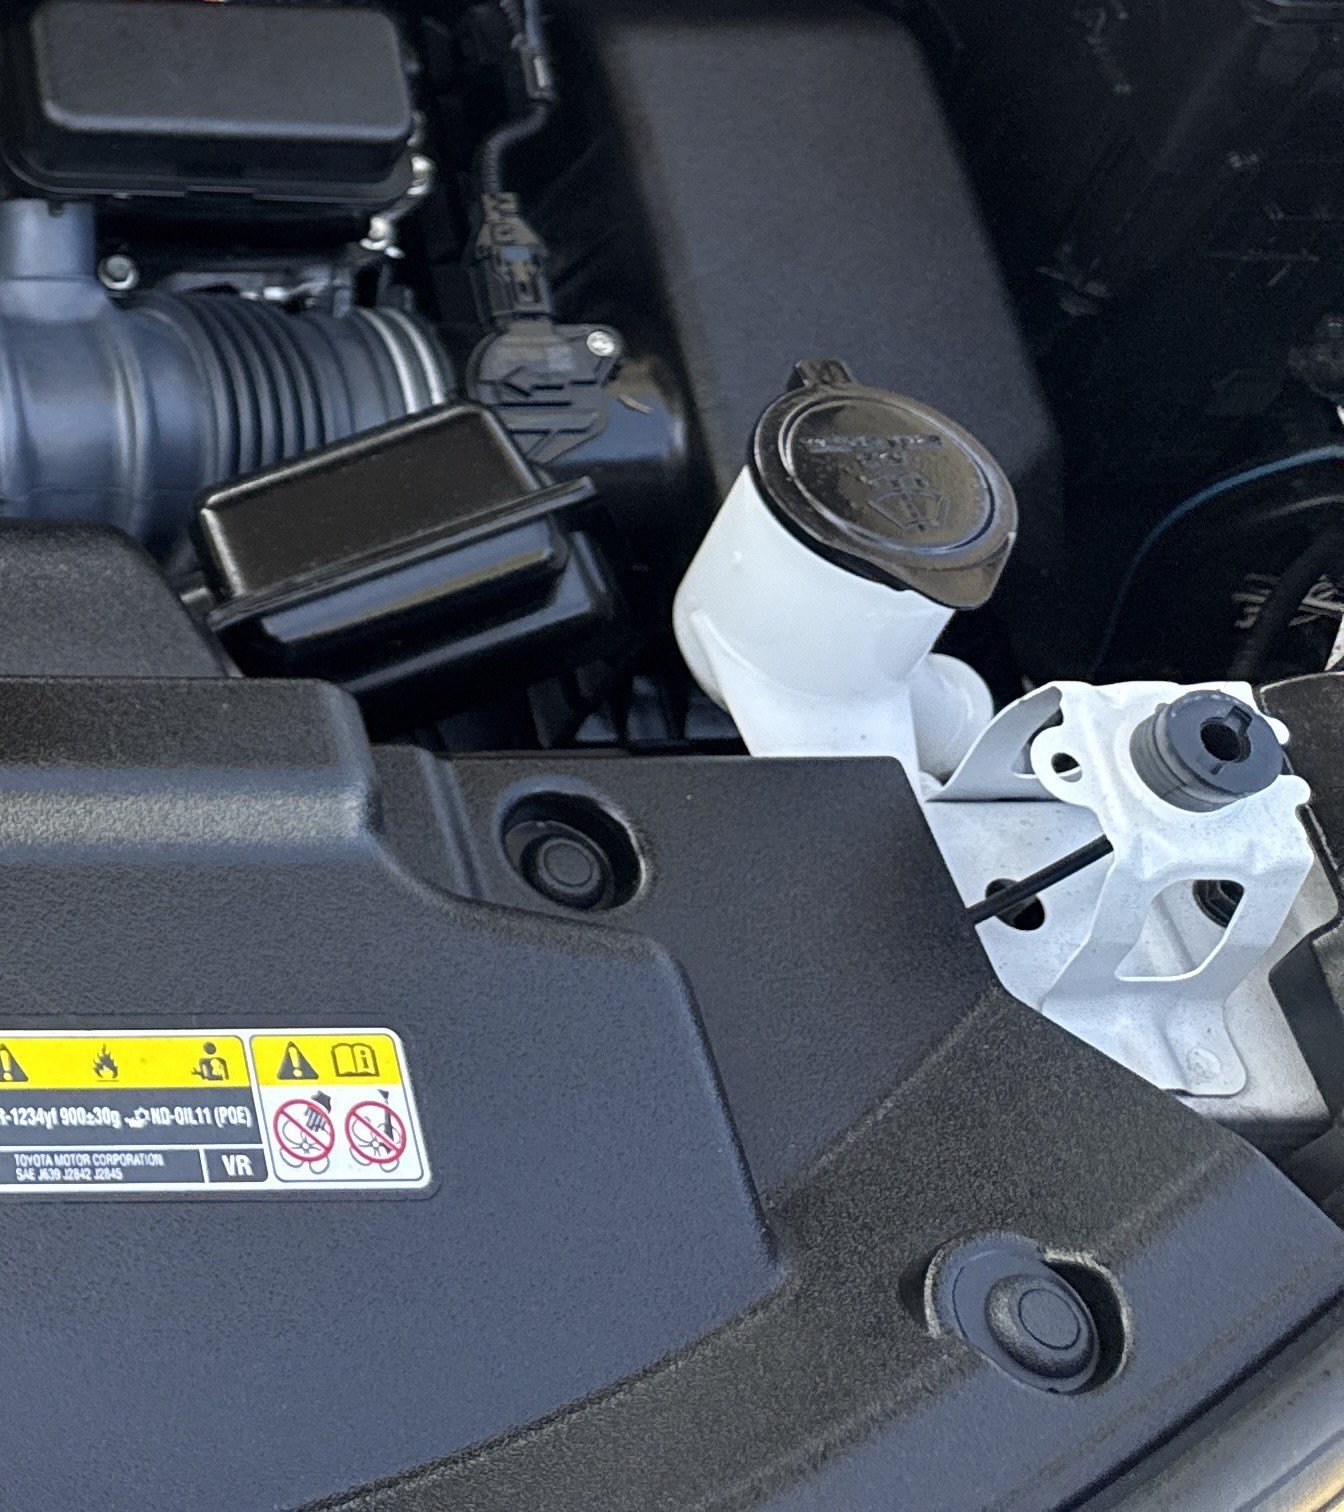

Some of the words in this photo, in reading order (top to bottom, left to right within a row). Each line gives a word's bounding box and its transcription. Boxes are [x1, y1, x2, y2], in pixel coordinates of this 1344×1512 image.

[214, 1106, 252, 1128] (POE)
[14, 1153, 53, 1167] TOYOTA
[54, 1153, 92, 1167] MOTOR
[92, 1153, 165, 1166] CORPORATION
[221, 1154, 254, 1176] VR
[16, 1168, 35, 1181] SAE
